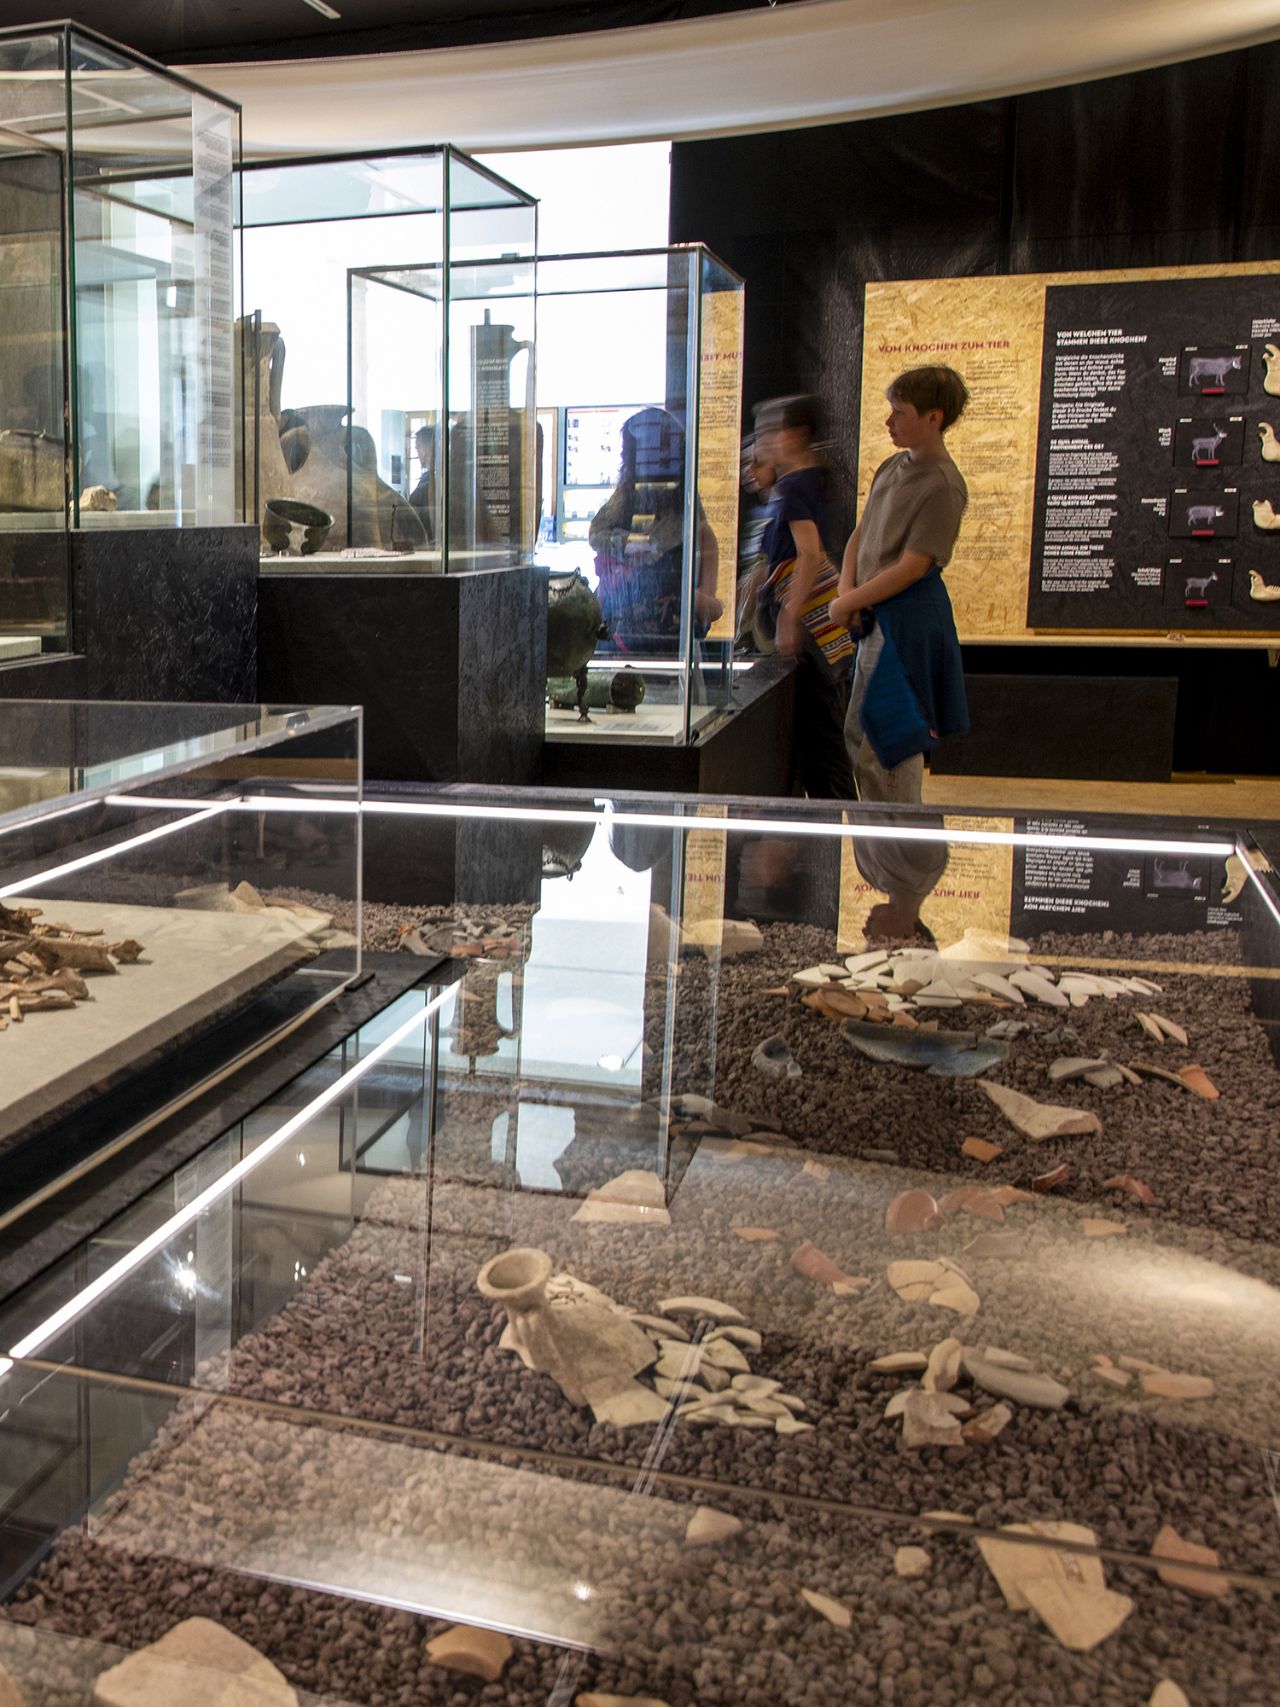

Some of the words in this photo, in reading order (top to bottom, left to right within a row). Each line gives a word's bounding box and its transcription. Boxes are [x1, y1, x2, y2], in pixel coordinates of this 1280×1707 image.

[1056, 338, 1088, 346] STAMMEN
[1089, 337, 1108, 345] DIESE
[879, 345, 902, 353] VOM
[905, 343, 957, 352] KNOCHEN
[962, 342, 984, 350] ZUM
[987, 341, 1009, 349] TIER
